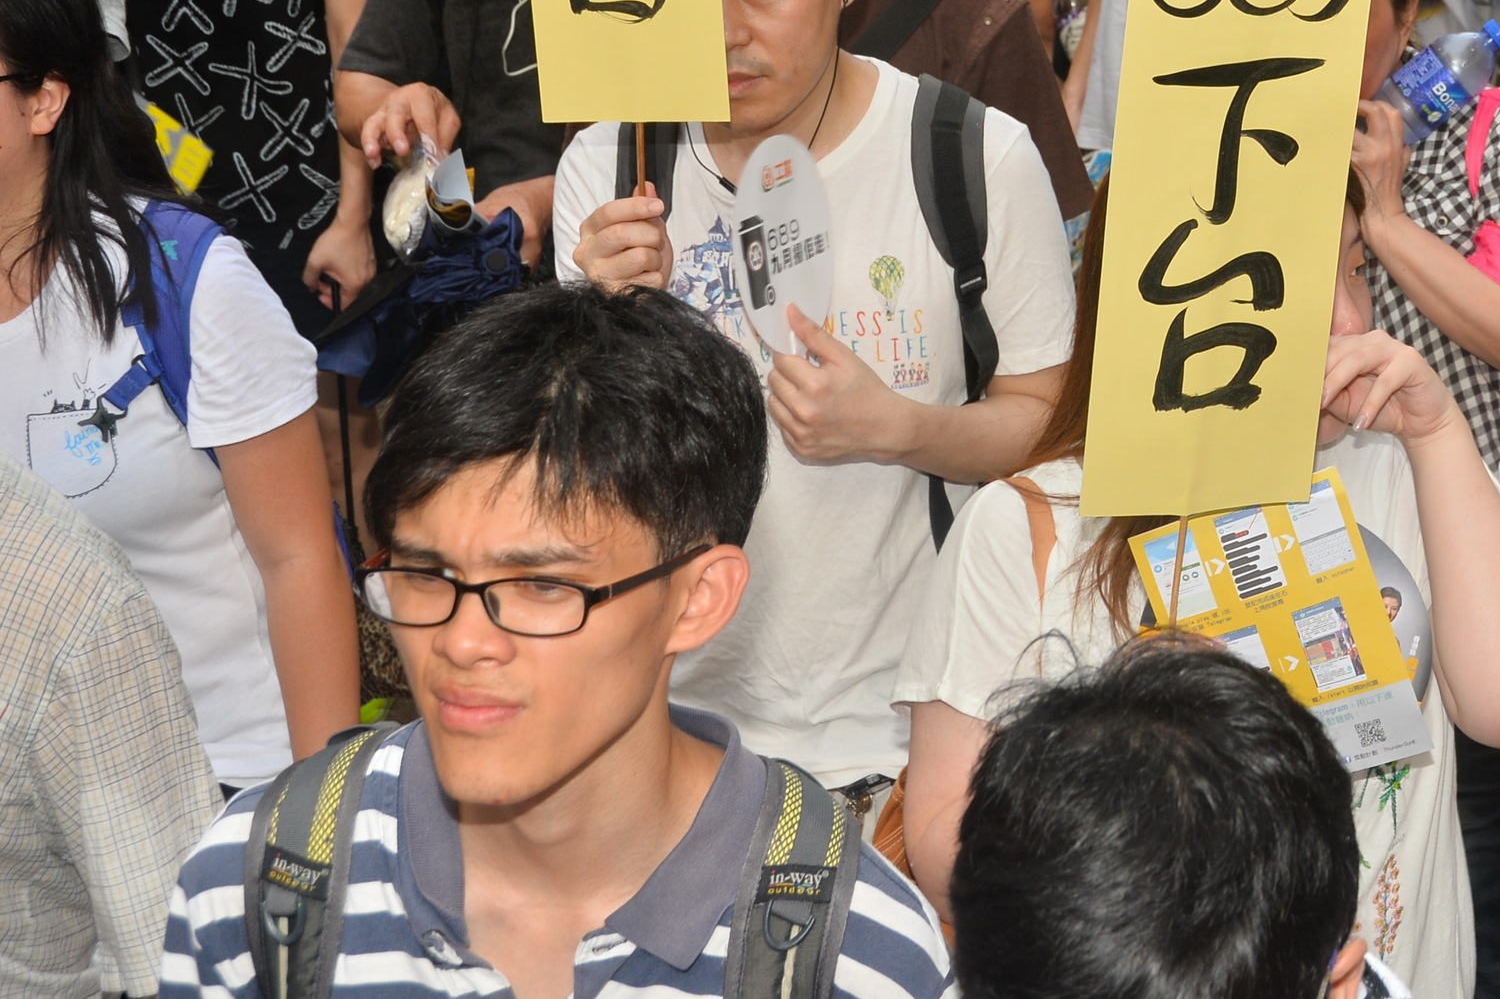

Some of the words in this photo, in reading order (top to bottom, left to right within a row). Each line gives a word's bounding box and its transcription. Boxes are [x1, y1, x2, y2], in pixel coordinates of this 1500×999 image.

[767, 218, 800, 251] 689
[1138, 57, 1326, 414] 下台
[898, 309, 924, 335] IS
